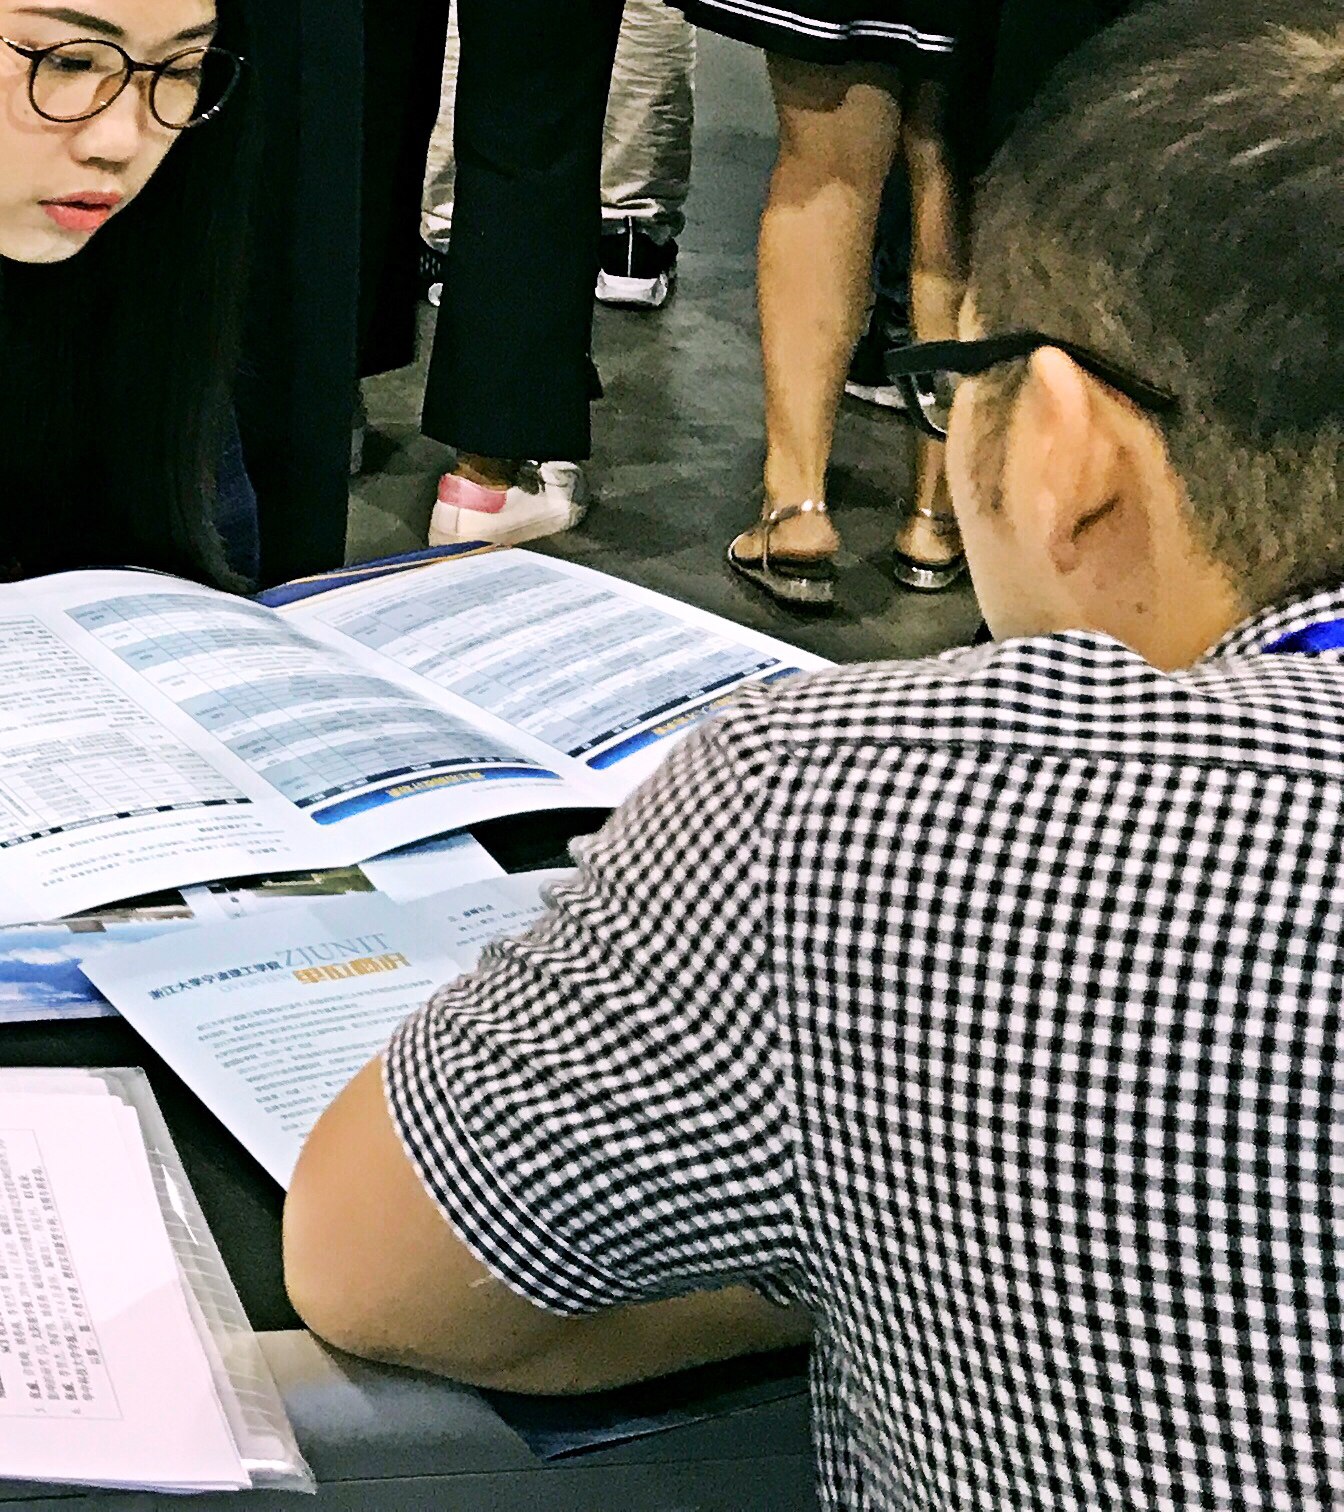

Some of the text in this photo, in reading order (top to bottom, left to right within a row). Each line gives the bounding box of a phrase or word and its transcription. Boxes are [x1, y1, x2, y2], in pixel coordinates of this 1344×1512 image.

[147, 958, 283, 1001] 浙江大学宁波理工学院
